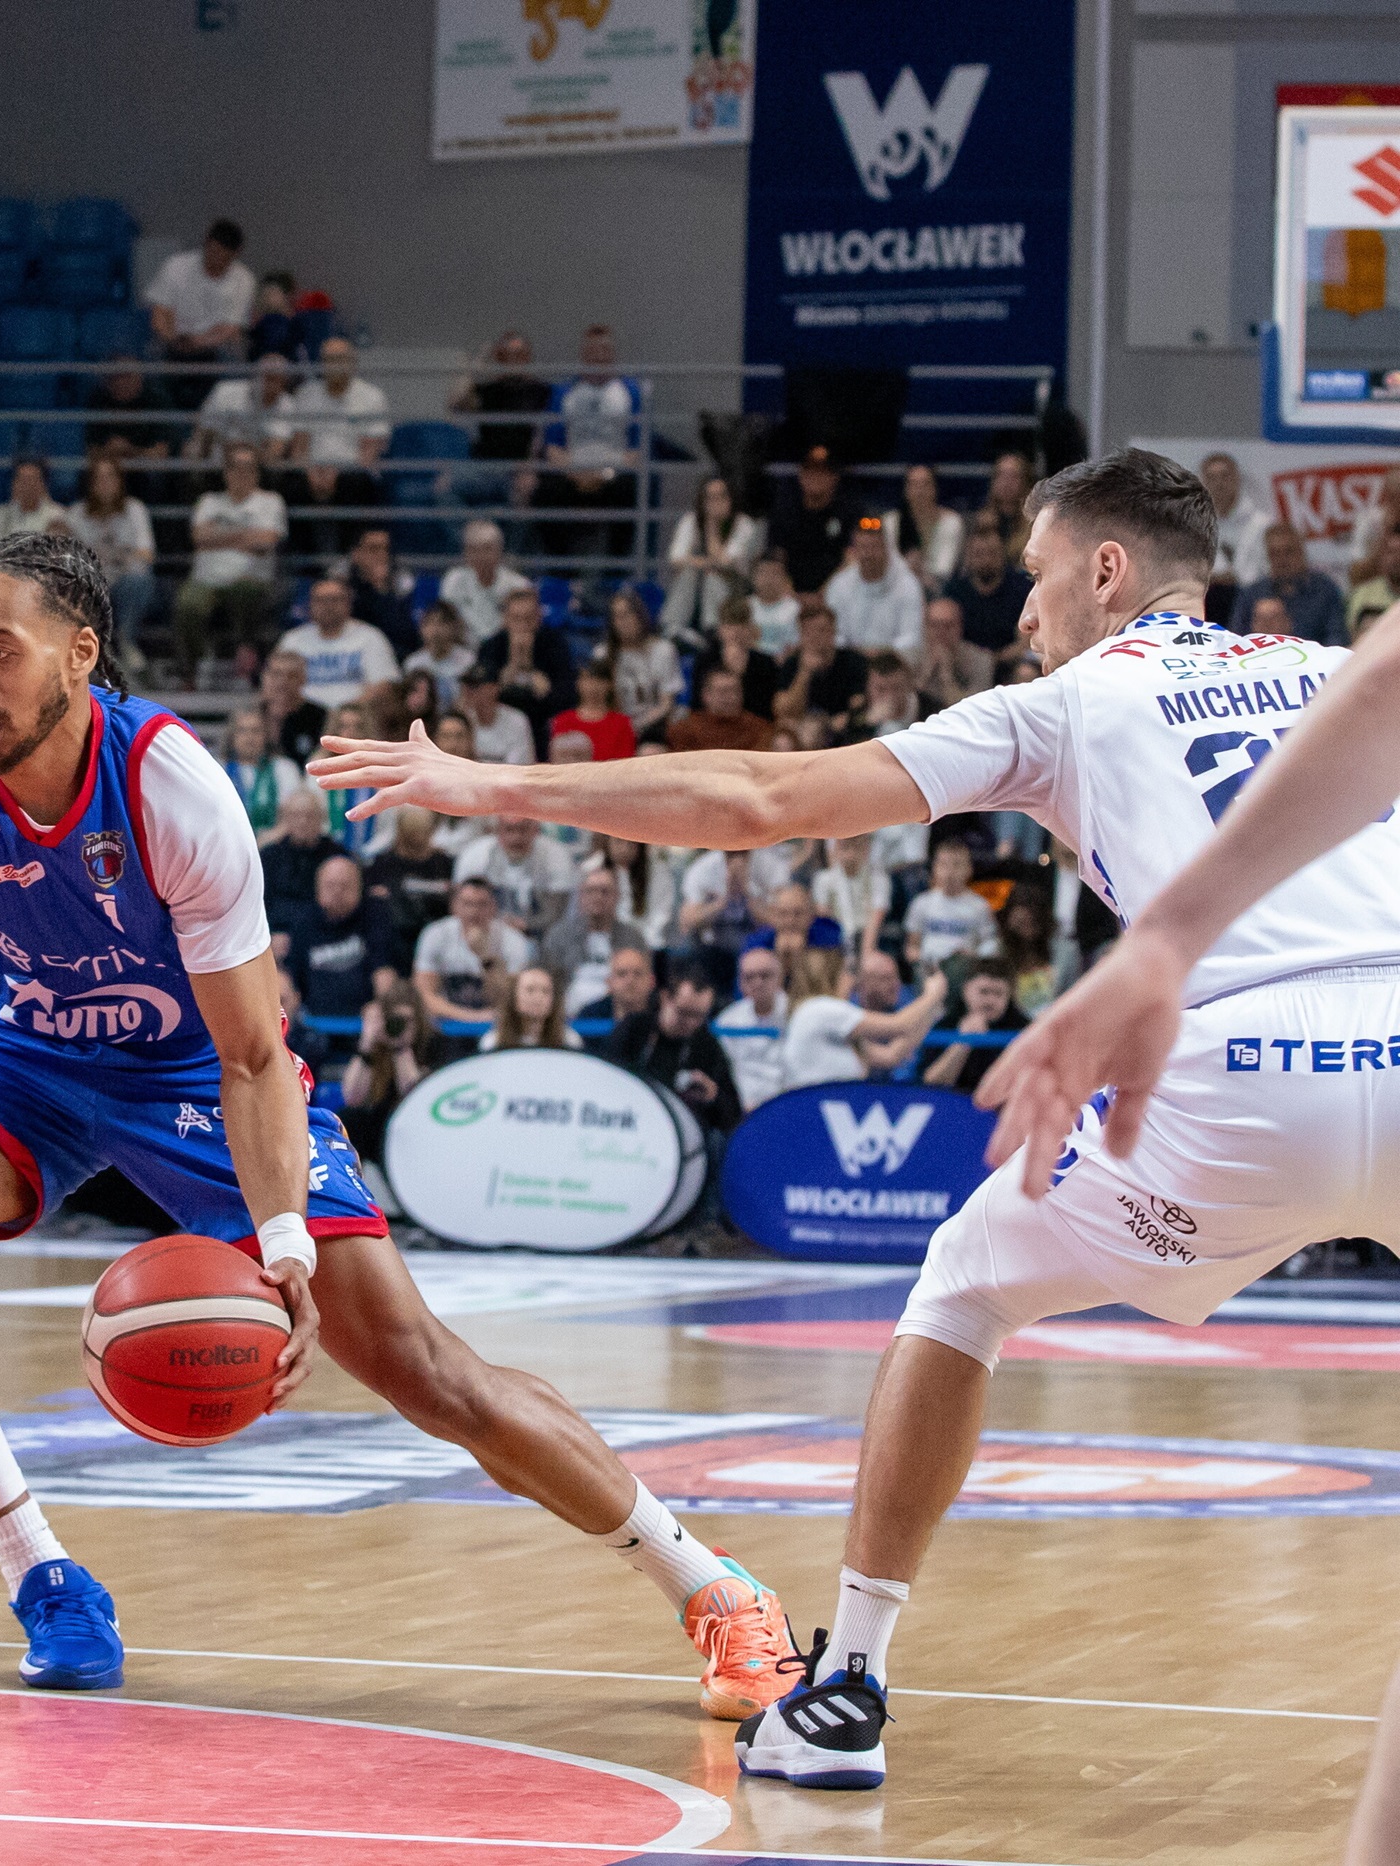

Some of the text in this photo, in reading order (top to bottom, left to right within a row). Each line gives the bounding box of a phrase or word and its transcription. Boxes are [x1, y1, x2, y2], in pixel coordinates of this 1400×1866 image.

[780, 223, 1025, 277] WŁOCŁAWEK
[1172, 631, 1212, 646] 4F
[579, 1101, 637, 1131] Bank
[308, 1164, 329, 1191] F
[1116, 1195, 1197, 1265] JAWORSKI
[168, 1345, 260, 1366] molten
